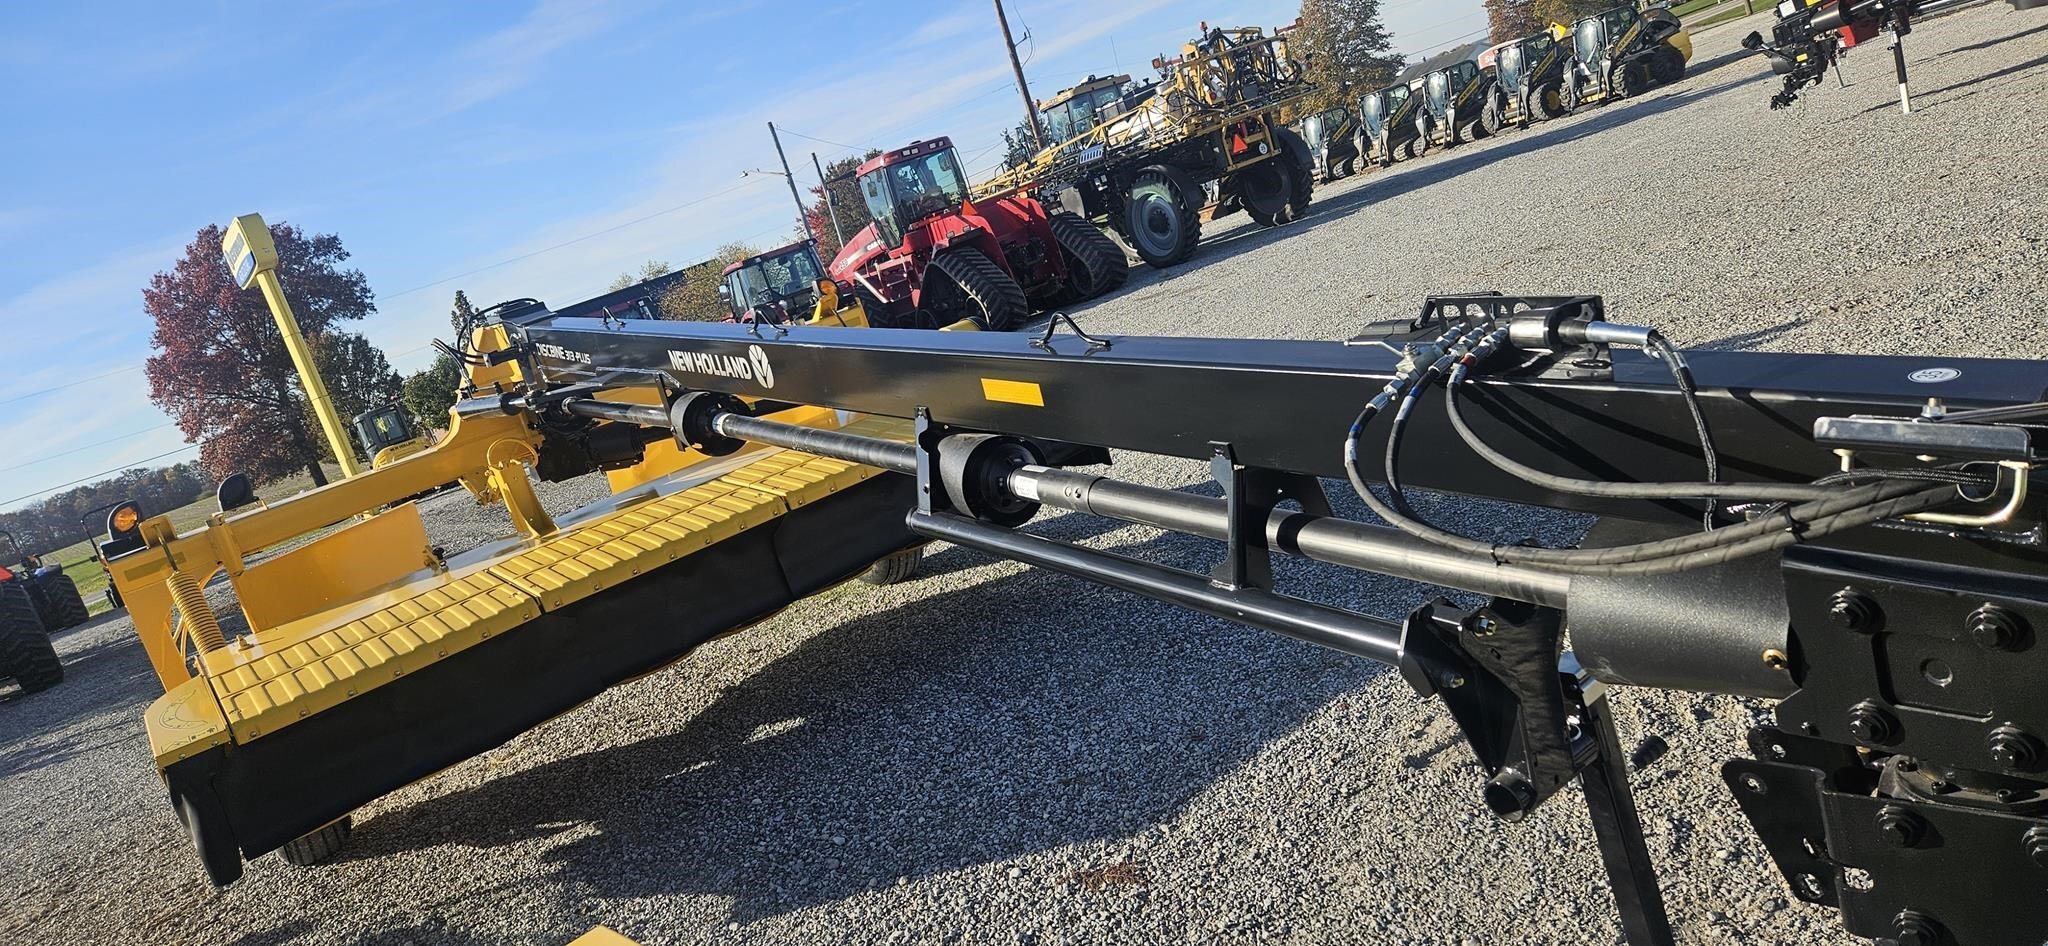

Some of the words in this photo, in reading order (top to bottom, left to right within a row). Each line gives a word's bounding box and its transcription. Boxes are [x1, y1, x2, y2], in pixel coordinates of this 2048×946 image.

[535, 342, 566, 360] DISCBINE
[564, 349, 575, 361] 313
[667, 349, 695, 372] NEW
[692, 351, 752, 380] HOLLAND
